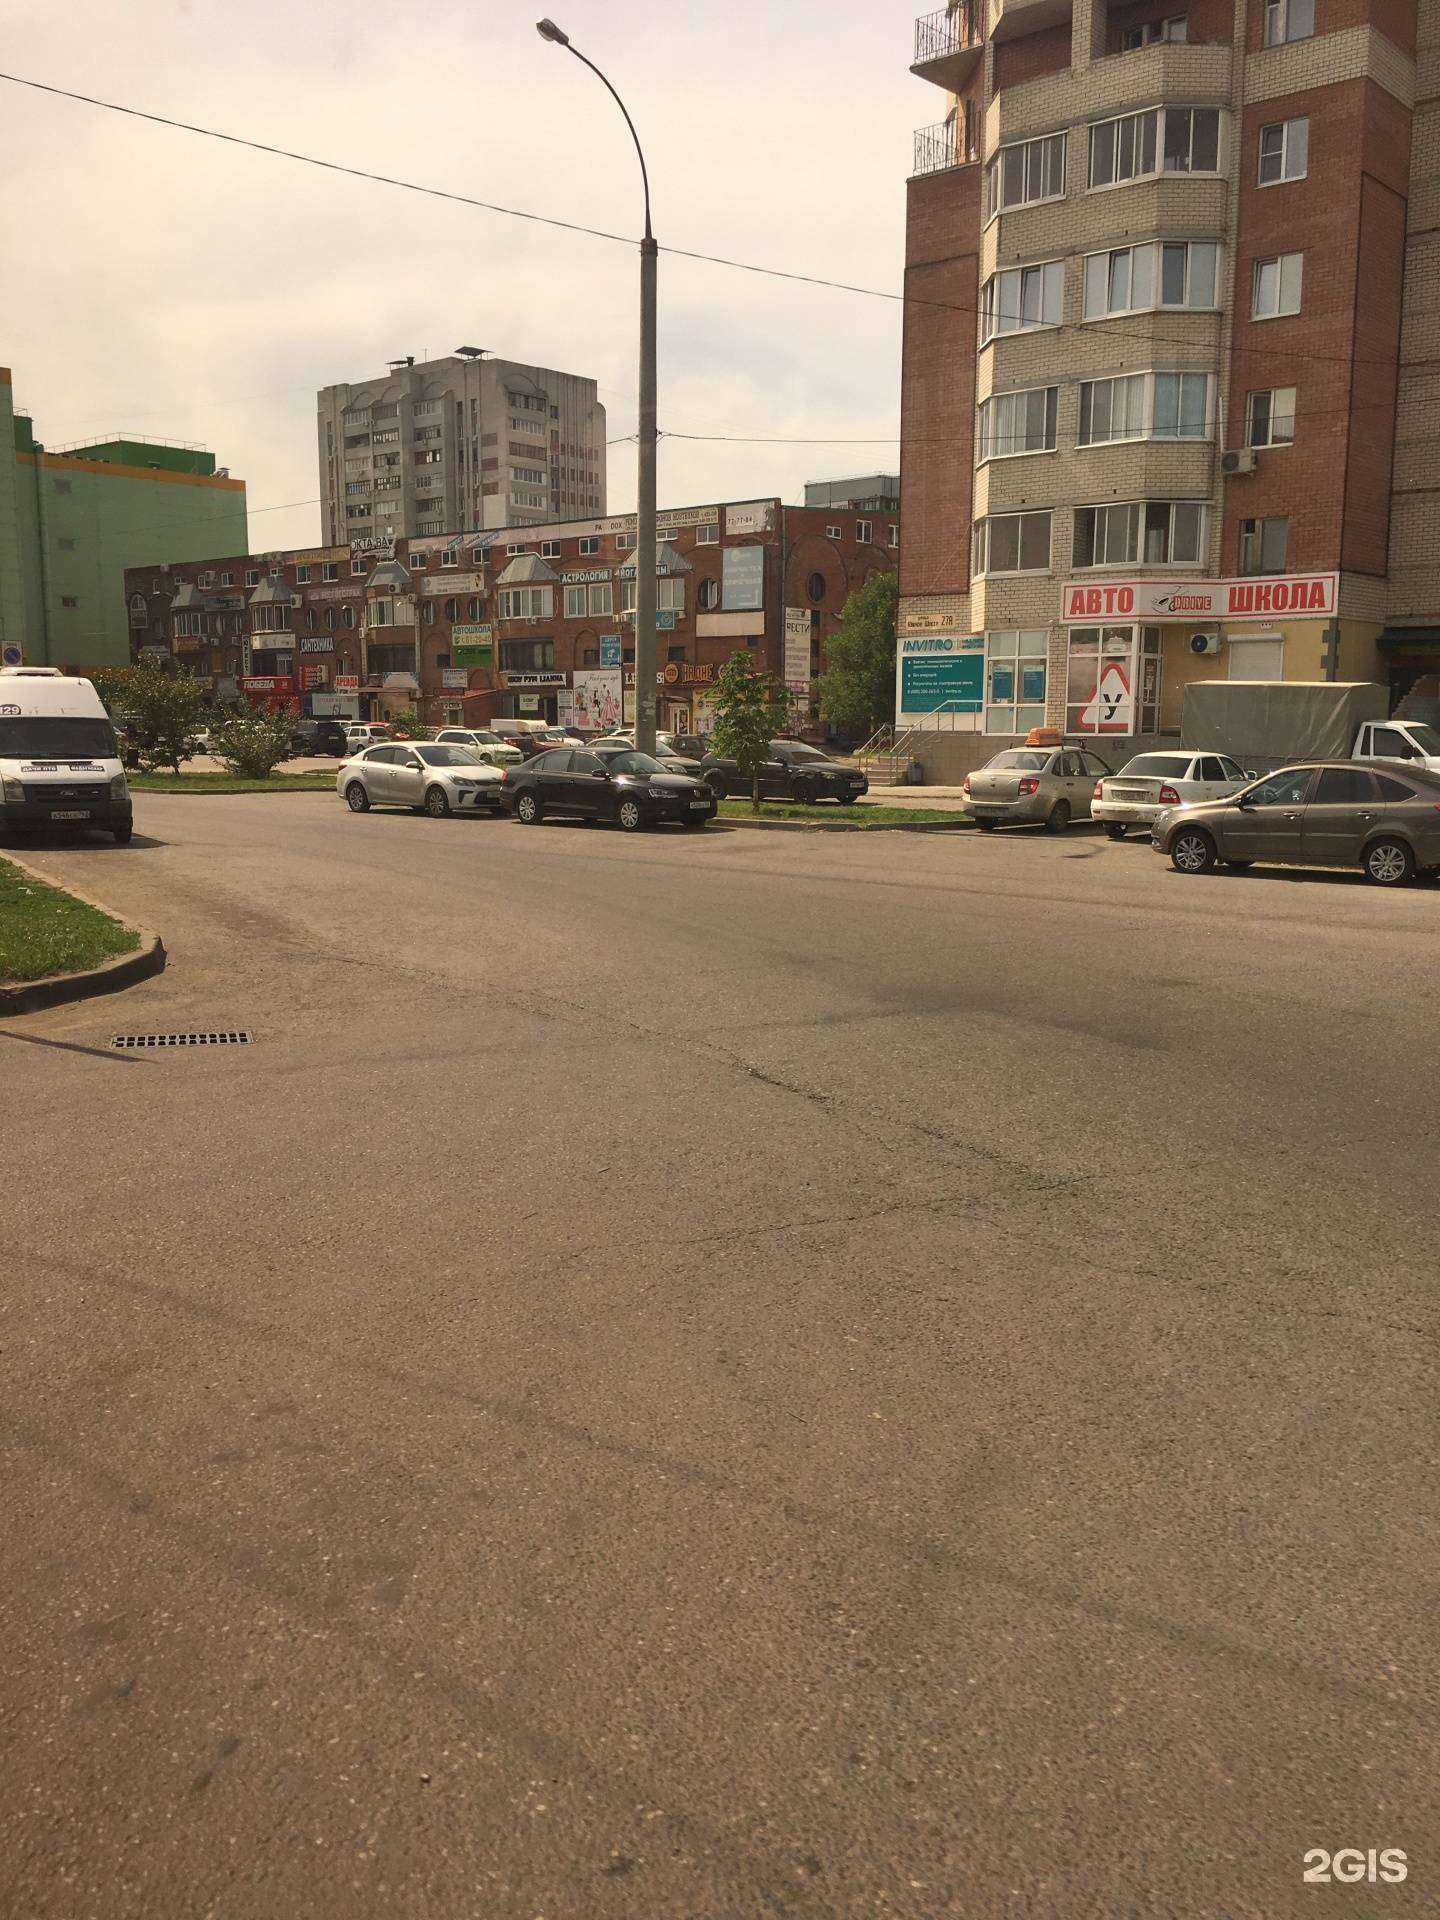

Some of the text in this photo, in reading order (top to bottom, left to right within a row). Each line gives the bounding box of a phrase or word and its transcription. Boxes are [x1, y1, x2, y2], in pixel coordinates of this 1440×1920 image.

[561, 569, 609, 583] АСТРОЛОГИЯ
[1069, 586, 1134, 615] АВТО
[1173, 594, 1212, 611] DRIVE
[1228, 581, 1326, 613] ШКОЛА
[453, 625, 491, 635] АВТОШКОЛА
[301, 637, 334, 653] САНТЕХНИКА
[903, 638, 953, 653] INVITRO
